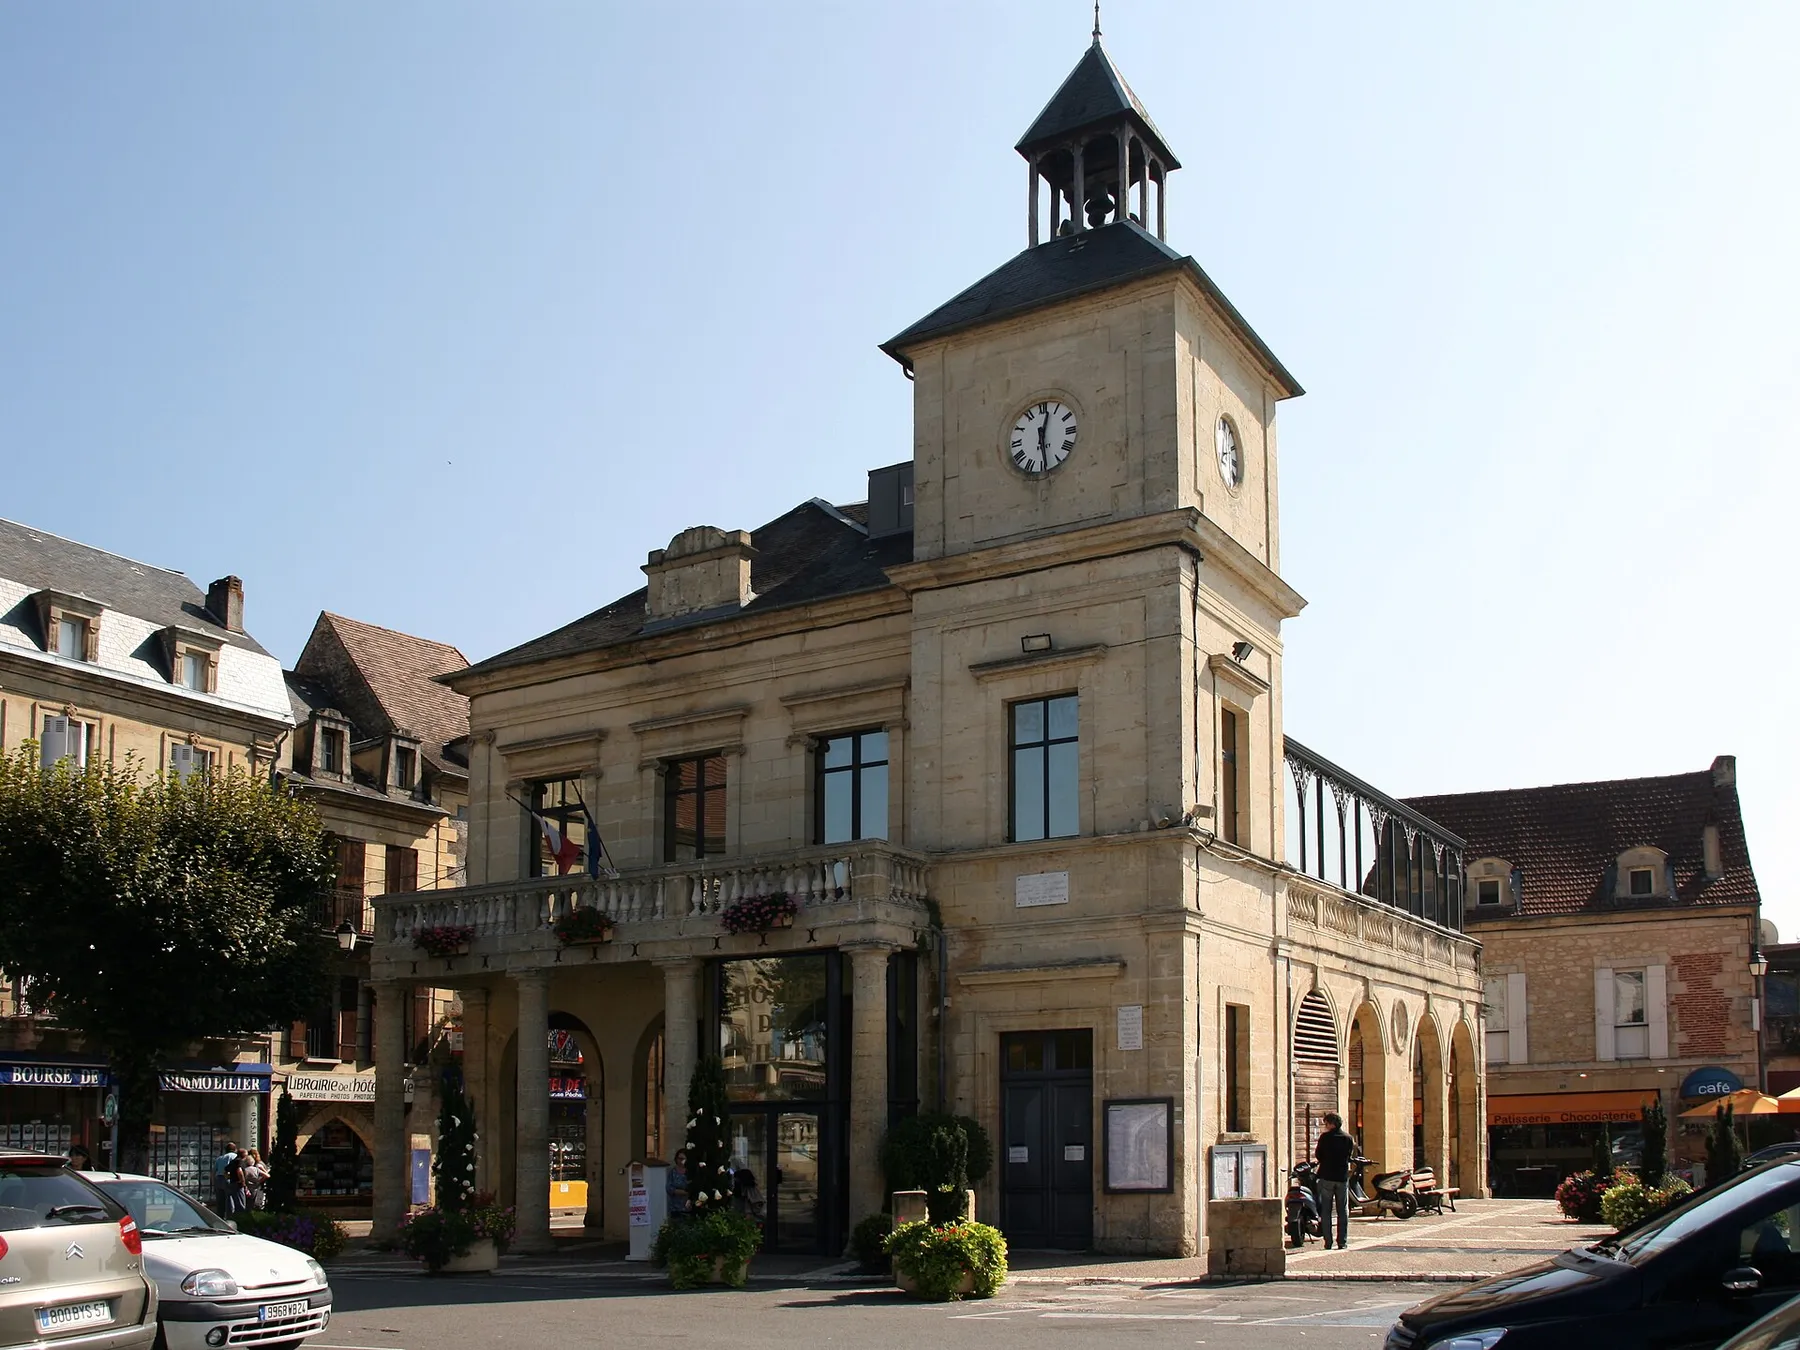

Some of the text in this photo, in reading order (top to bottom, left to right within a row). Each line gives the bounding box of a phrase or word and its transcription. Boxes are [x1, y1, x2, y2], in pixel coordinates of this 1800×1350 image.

[12, 1066, 99, 1084] BOURSE DE
[1698, 1081, 1730, 1095] café
[1494, 1110, 1637, 1124] Patisserie Chocolaterie
